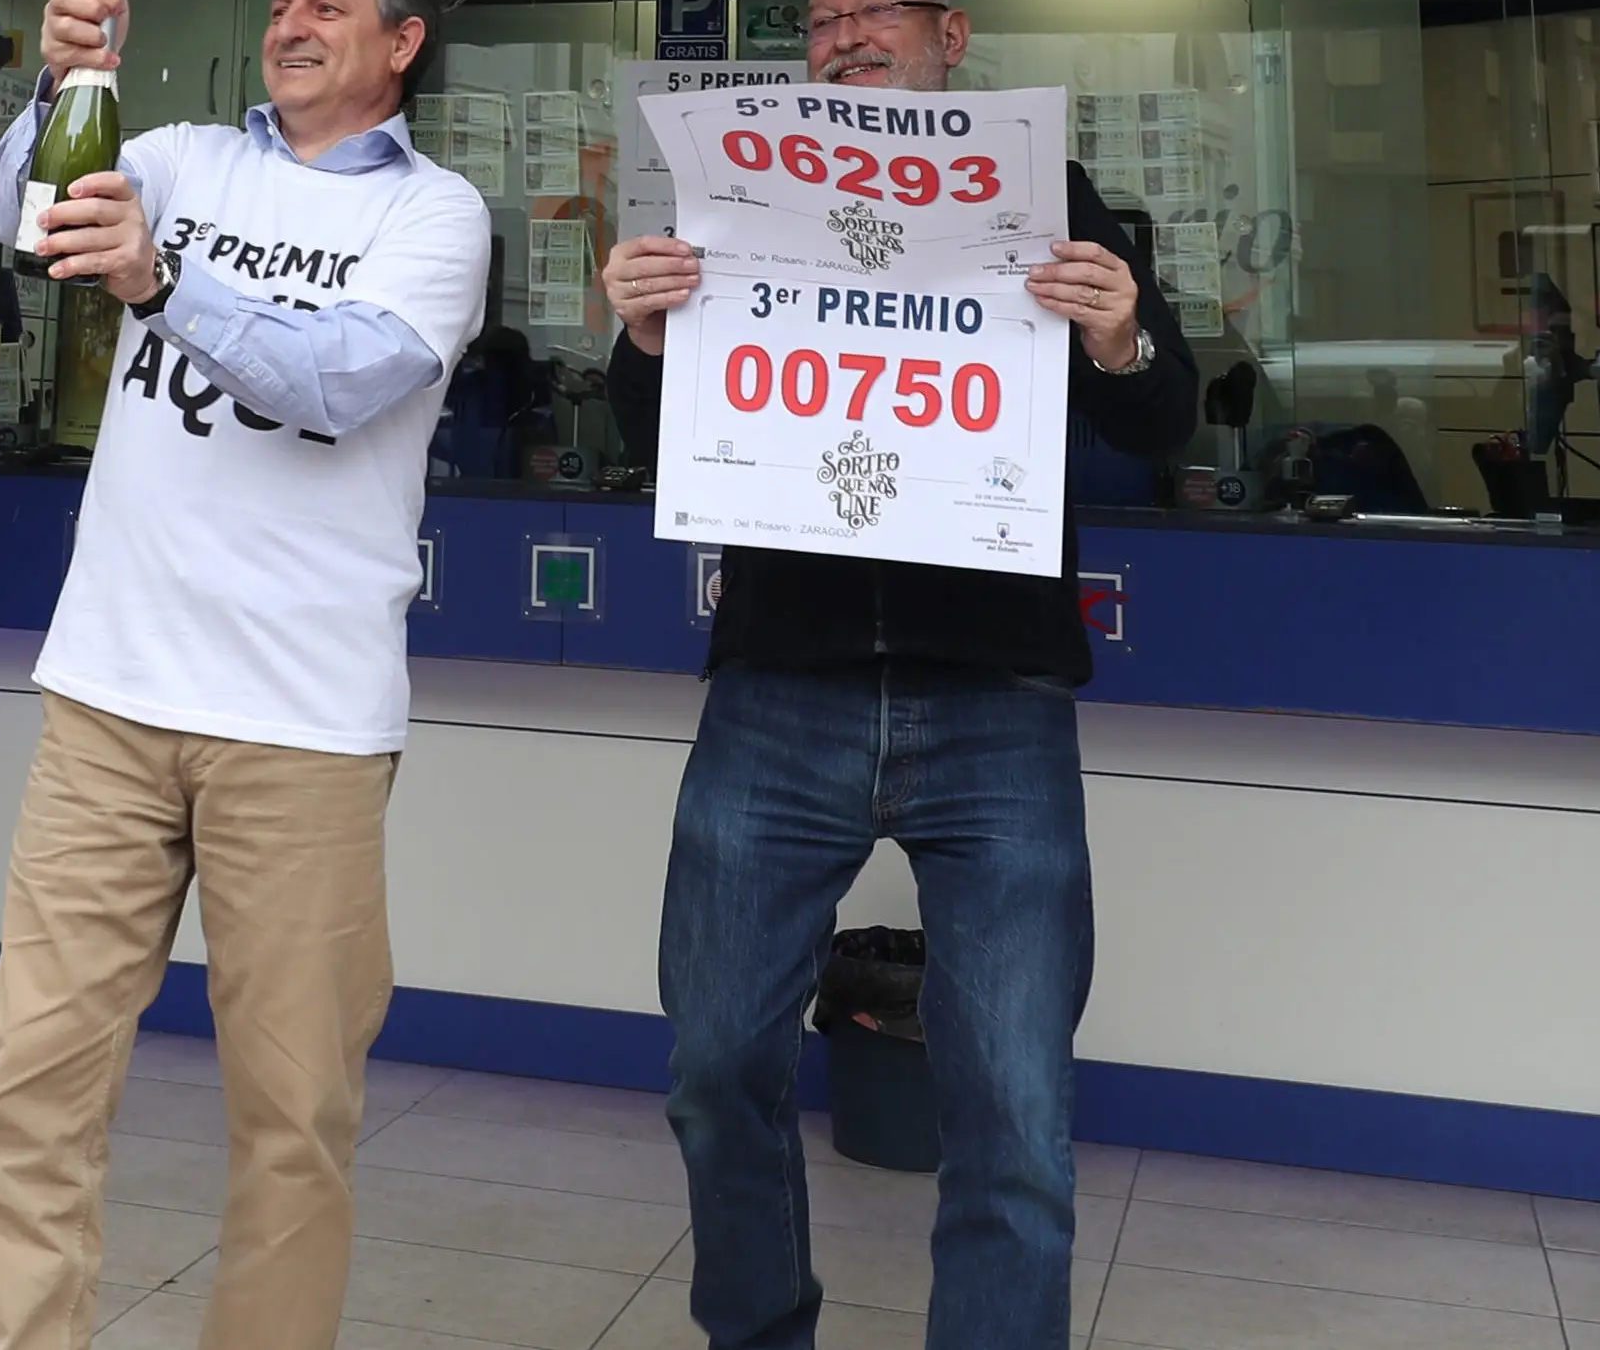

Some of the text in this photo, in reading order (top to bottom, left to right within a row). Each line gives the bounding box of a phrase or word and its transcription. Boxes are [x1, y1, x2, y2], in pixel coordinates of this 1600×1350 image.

[665, 46, 719, 59] GRATIS
[736, 96, 971, 137] 5º PREMIO
[722, 130, 1001, 207] 06293
[162, 217, 217, 251] 3er
[826, 209, 904, 236] SORTEO
[846, 230, 873, 244] QUE
[750, 282, 983, 335] 3er PREMIO
[724, 343, 1002, 433] 00750
[816, 450, 901, 484] SORTEO
[836, 473, 898, 499] QUE NOS
[755, 520, 791, 533] Rosario
[799, 524, 858, 539] ZARAGOZA
